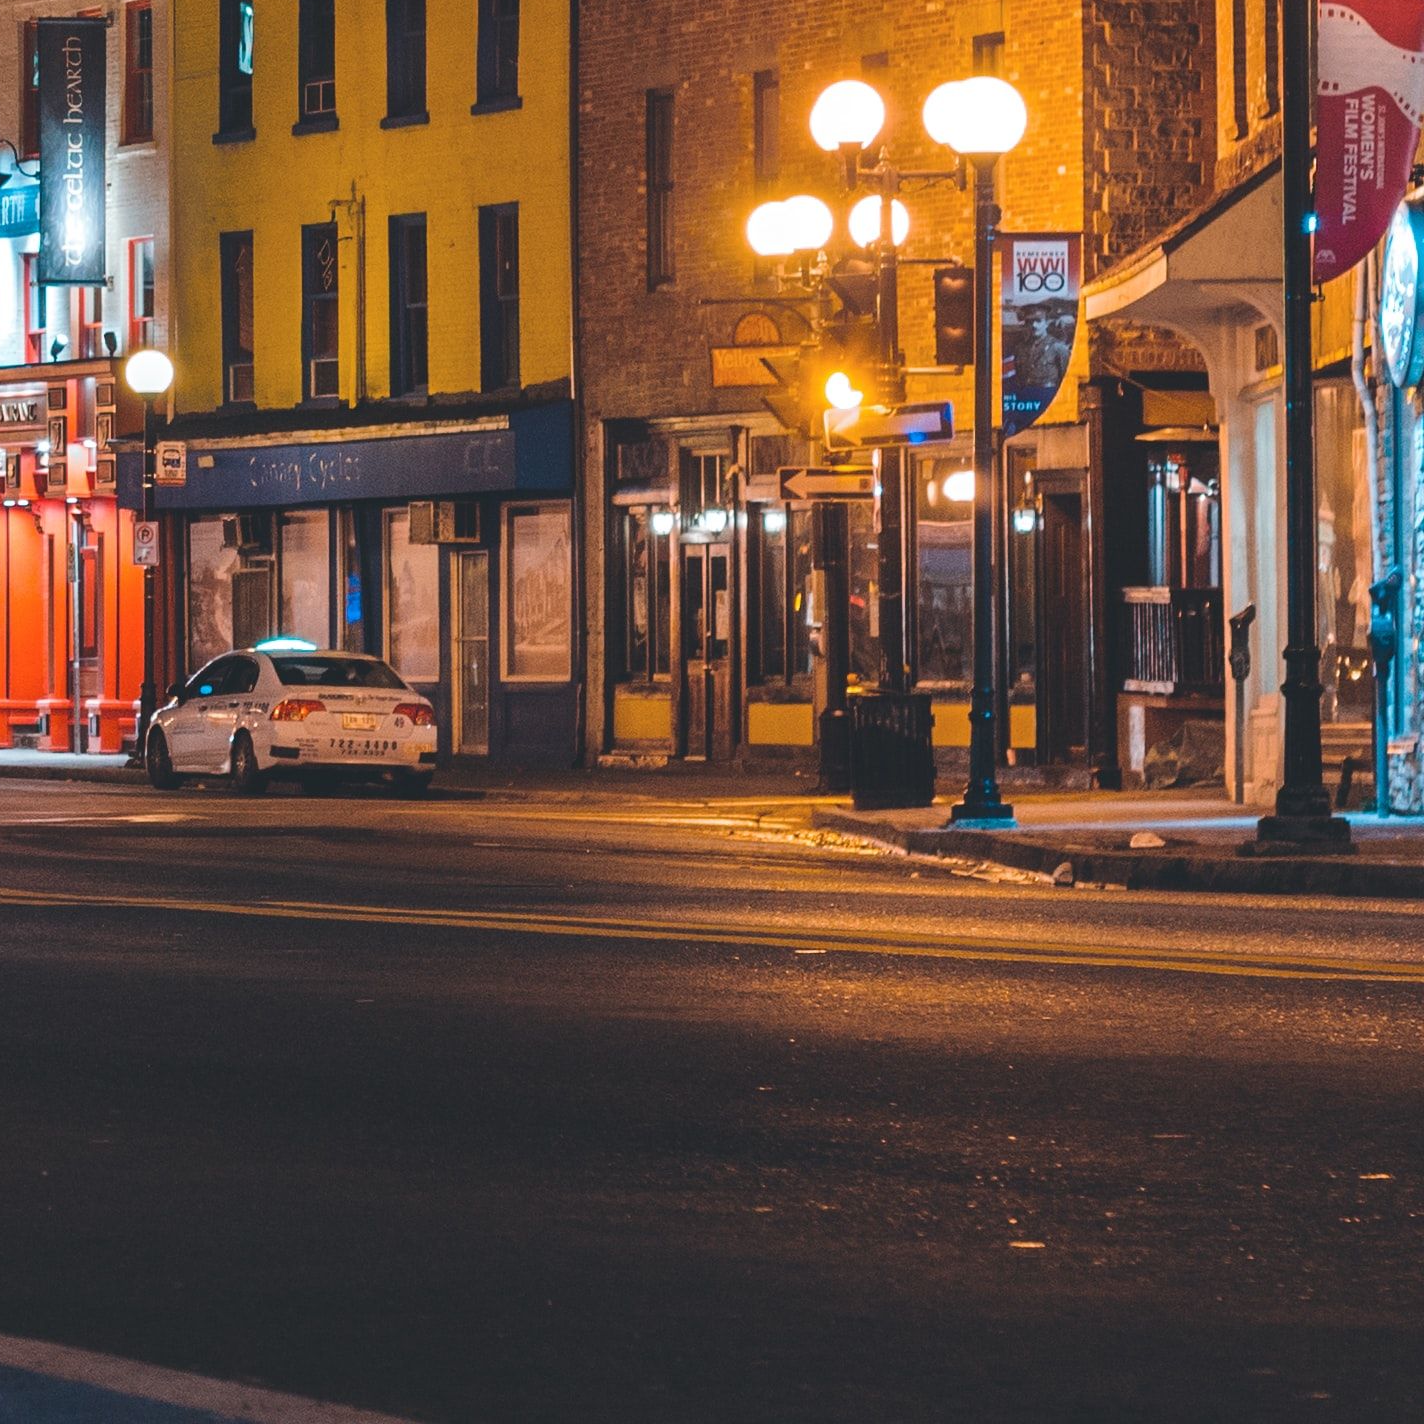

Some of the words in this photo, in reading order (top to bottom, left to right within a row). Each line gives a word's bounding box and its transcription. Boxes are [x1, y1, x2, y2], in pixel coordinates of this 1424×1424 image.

[1345, 97, 1359, 140] FILM
[1360, 93, 1376, 182] WOMEN'S
[1342, 143, 1358, 225] FESTIVAL
[1016, 272, 1065, 293] 100
[1004, 402, 1041, 411] STORY
